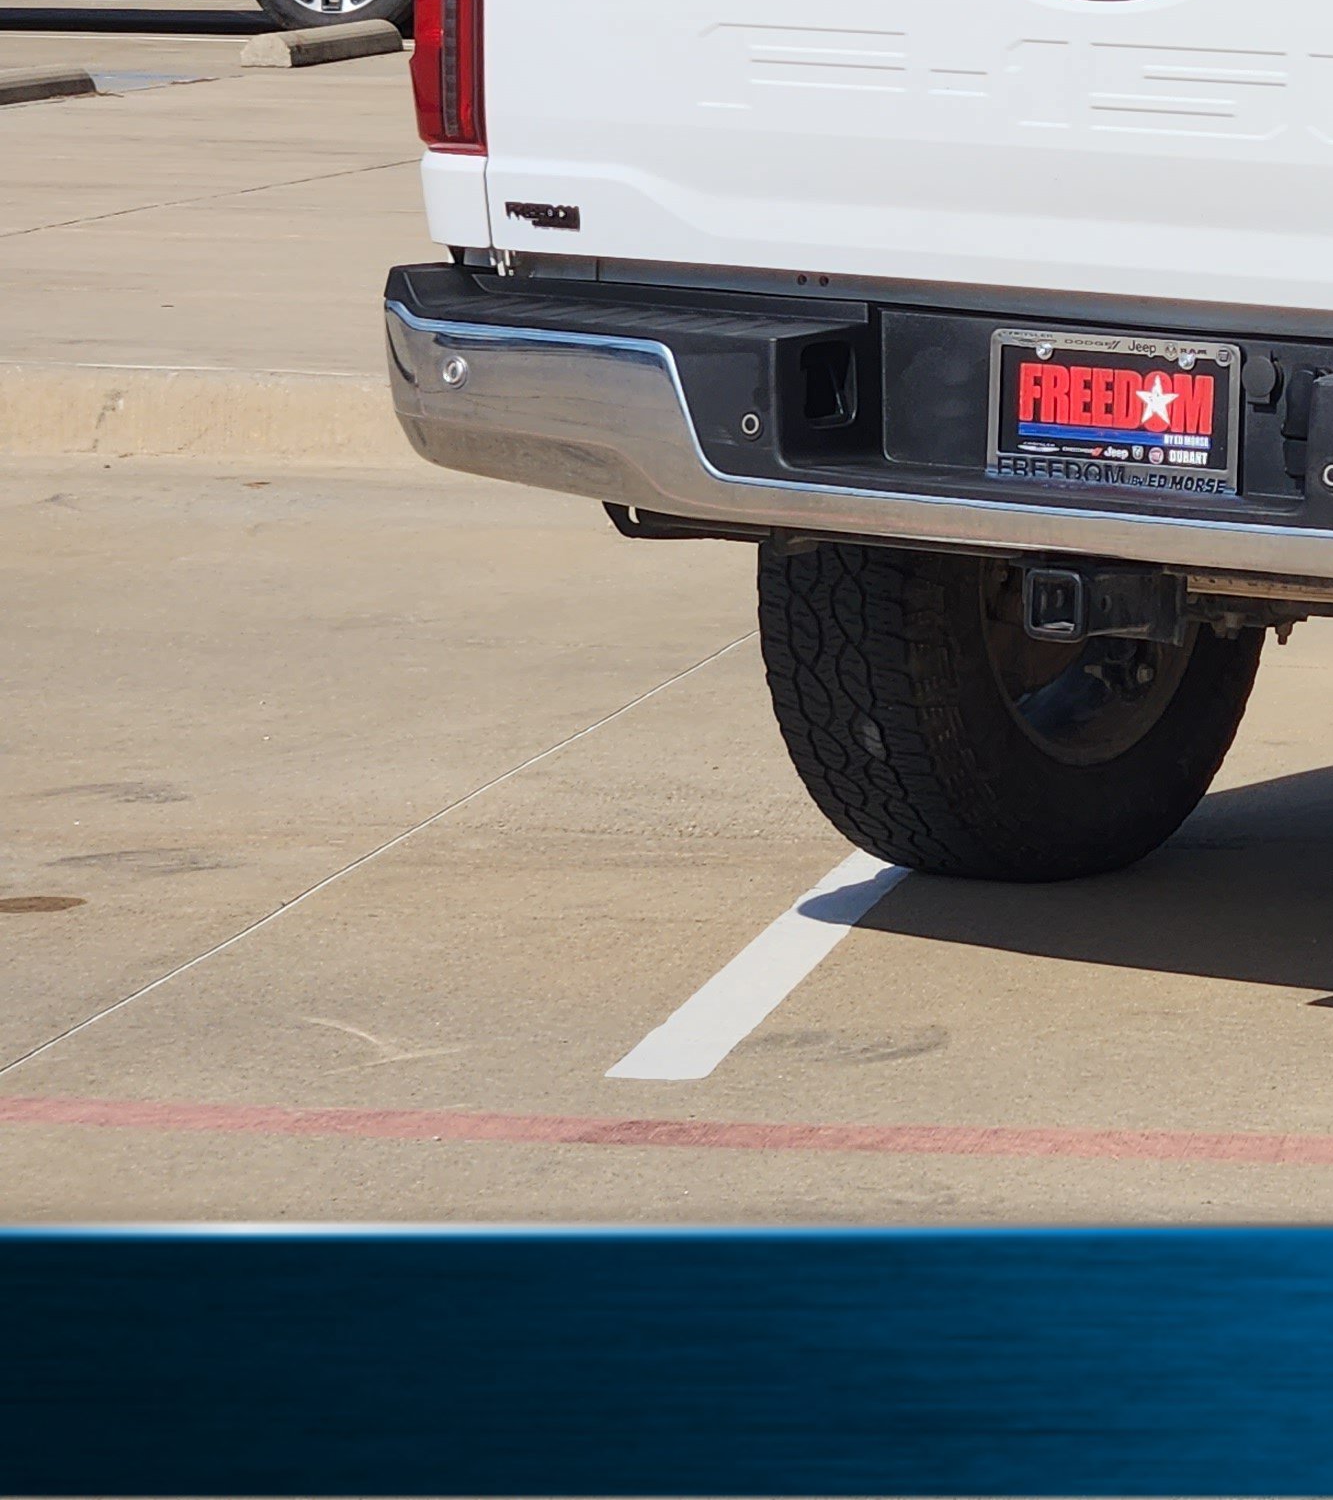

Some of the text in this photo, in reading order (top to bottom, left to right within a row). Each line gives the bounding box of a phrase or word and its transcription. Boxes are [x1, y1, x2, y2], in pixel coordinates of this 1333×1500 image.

[1128, 340, 1157, 355] Jeep
[1019, 362, 1215, 435] FREEDOM
[1168, 449, 1209, 466] DURANT
[998, 457, 1126, 484] FREEDOM
[1149, 474, 1167, 488] ED
[1168, 475, 1227, 495] MORSE
